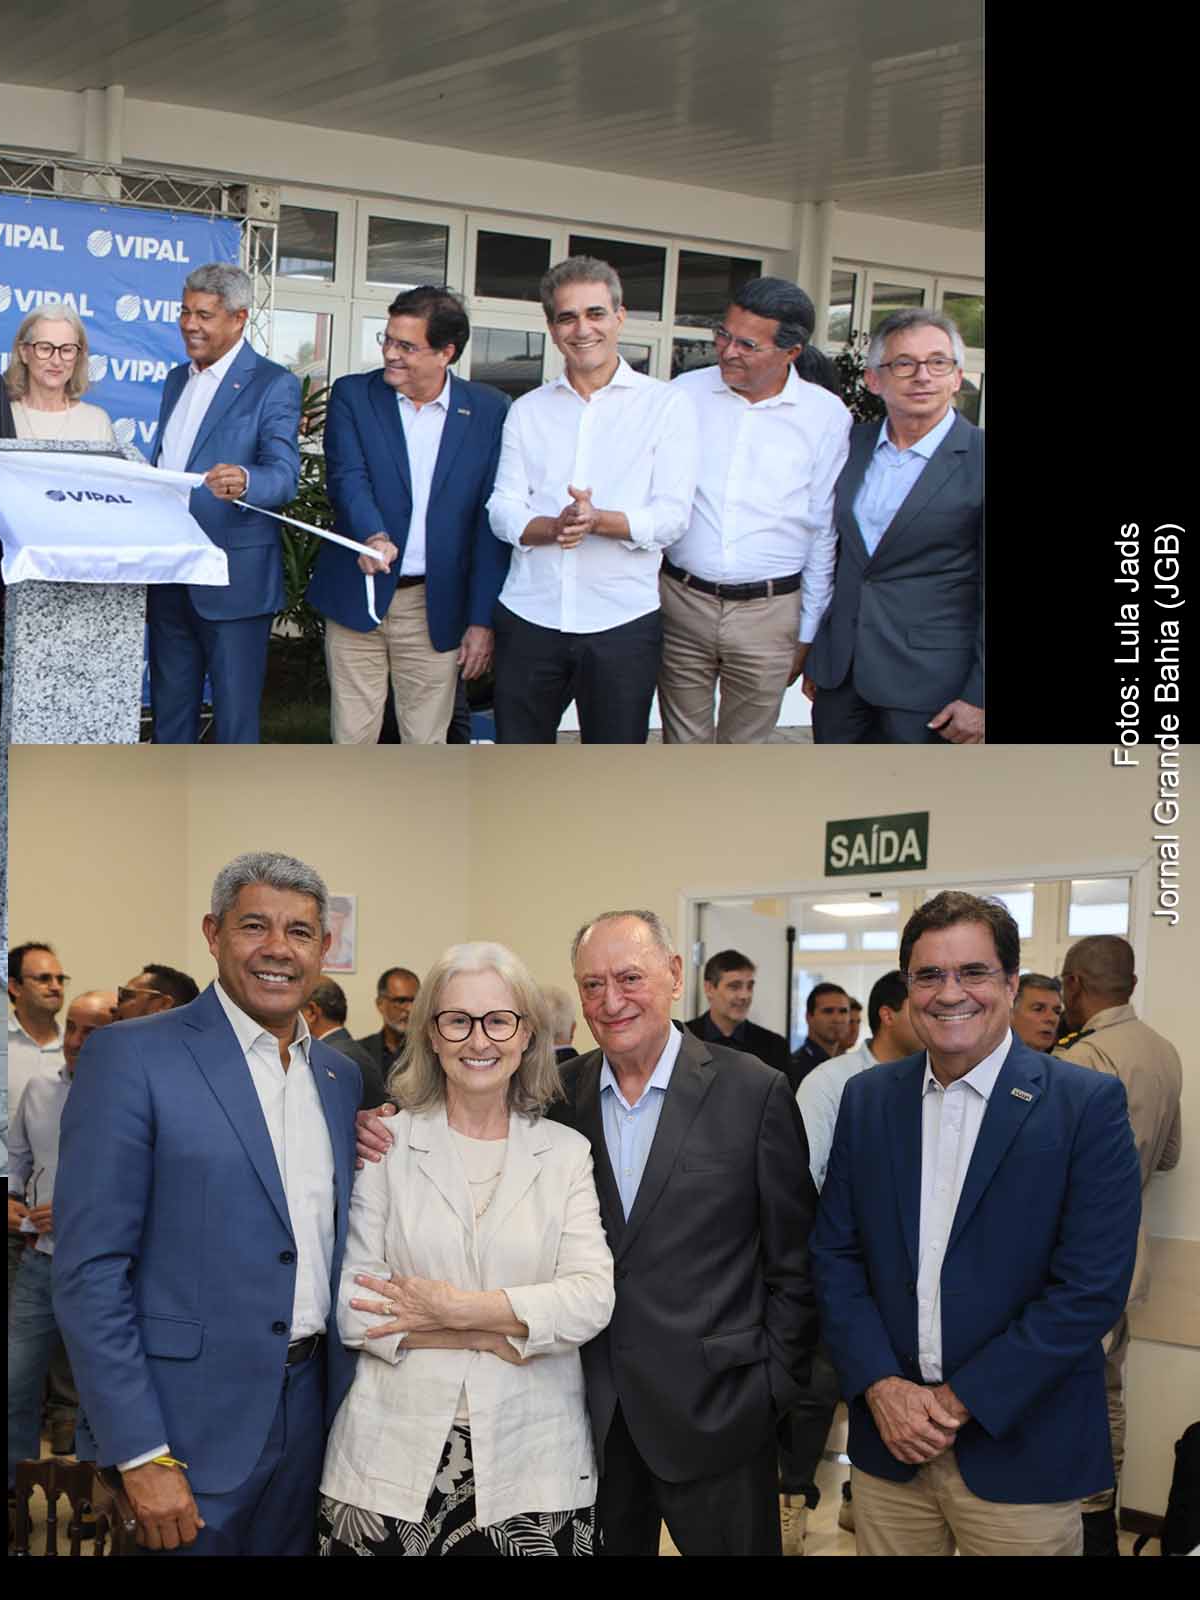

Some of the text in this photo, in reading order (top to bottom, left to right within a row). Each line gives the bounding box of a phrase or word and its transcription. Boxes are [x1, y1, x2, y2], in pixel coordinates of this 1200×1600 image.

[115, 235, 190, 263] VIPAL
[67, 491, 132, 504] VIPAL
[830, 824, 922, 868] SAÍDA
